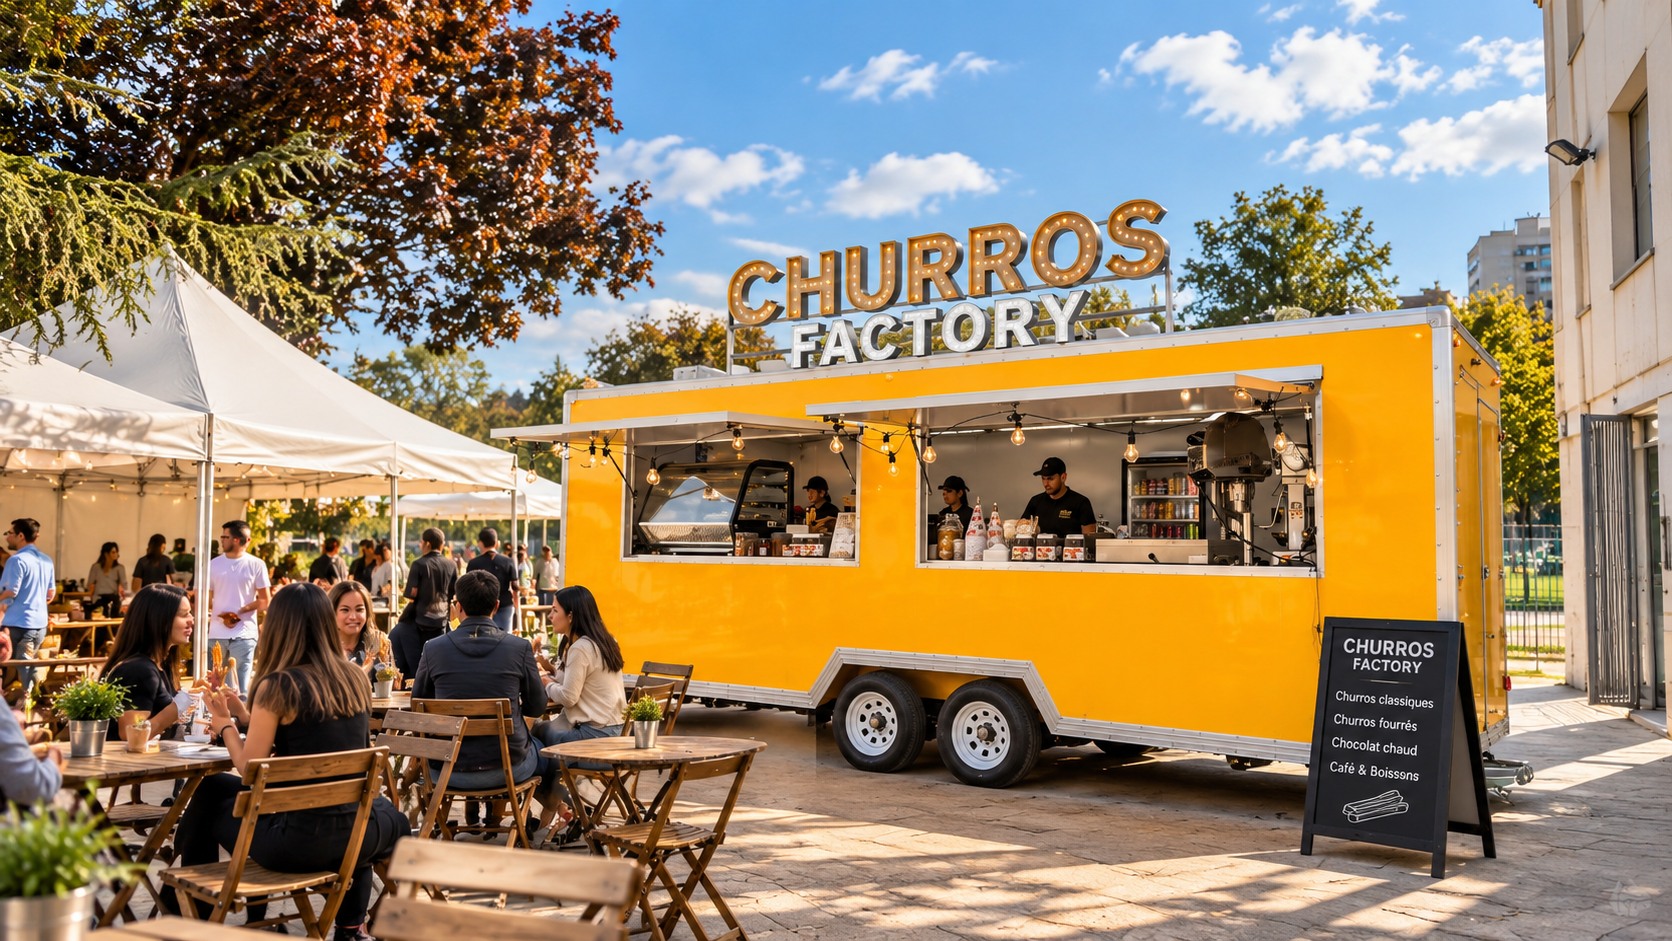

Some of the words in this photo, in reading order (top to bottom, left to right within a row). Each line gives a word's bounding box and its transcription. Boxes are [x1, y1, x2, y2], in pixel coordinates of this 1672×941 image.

[727, 199, 1170, 326] CHURROS
[791, 290, 1090, 369] FACTORY
[1343, 637, 1435, 659] CHURROS
[1352, 657, 1423, 674] FACTORY
[1335, 690, 1377, 705] Churros
[1378, 693, 1434, 710] classiques
[1333, 713, 1376, 728] Churros
[1378, 717, 1418, 732] fourrés
[1331, 736, 1381, 753] Chocolat
[1382, 742, 1418, 757] chaud
[1357, 763, 1367, 776] &
